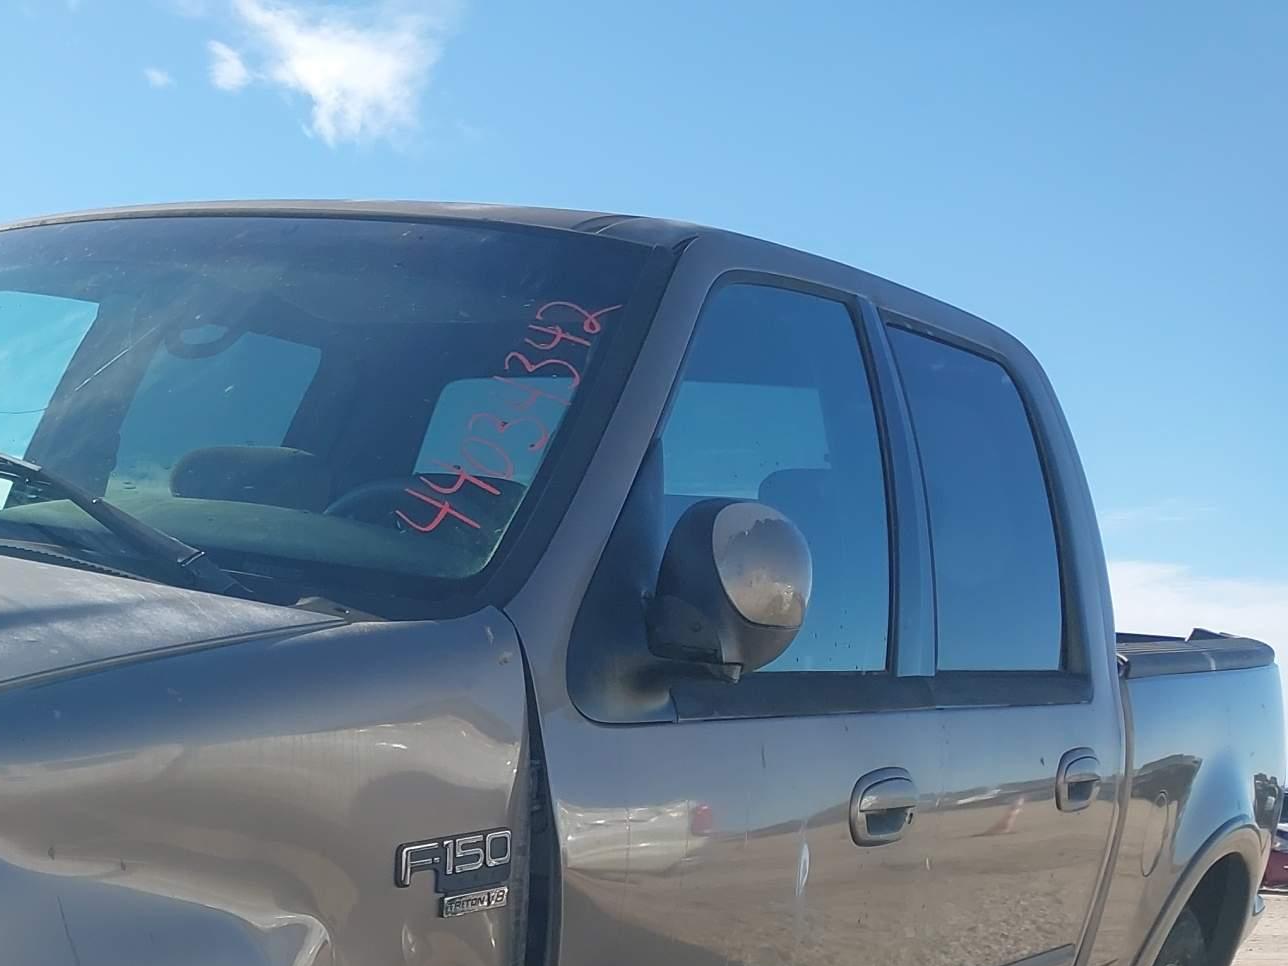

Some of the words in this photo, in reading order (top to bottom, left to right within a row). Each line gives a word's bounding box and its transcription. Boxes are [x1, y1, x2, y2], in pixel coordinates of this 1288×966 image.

[394, 300, 624, 532] 44034342
[401, 830, 512, 885] F-150
[486, 889, 506, 907] V8
